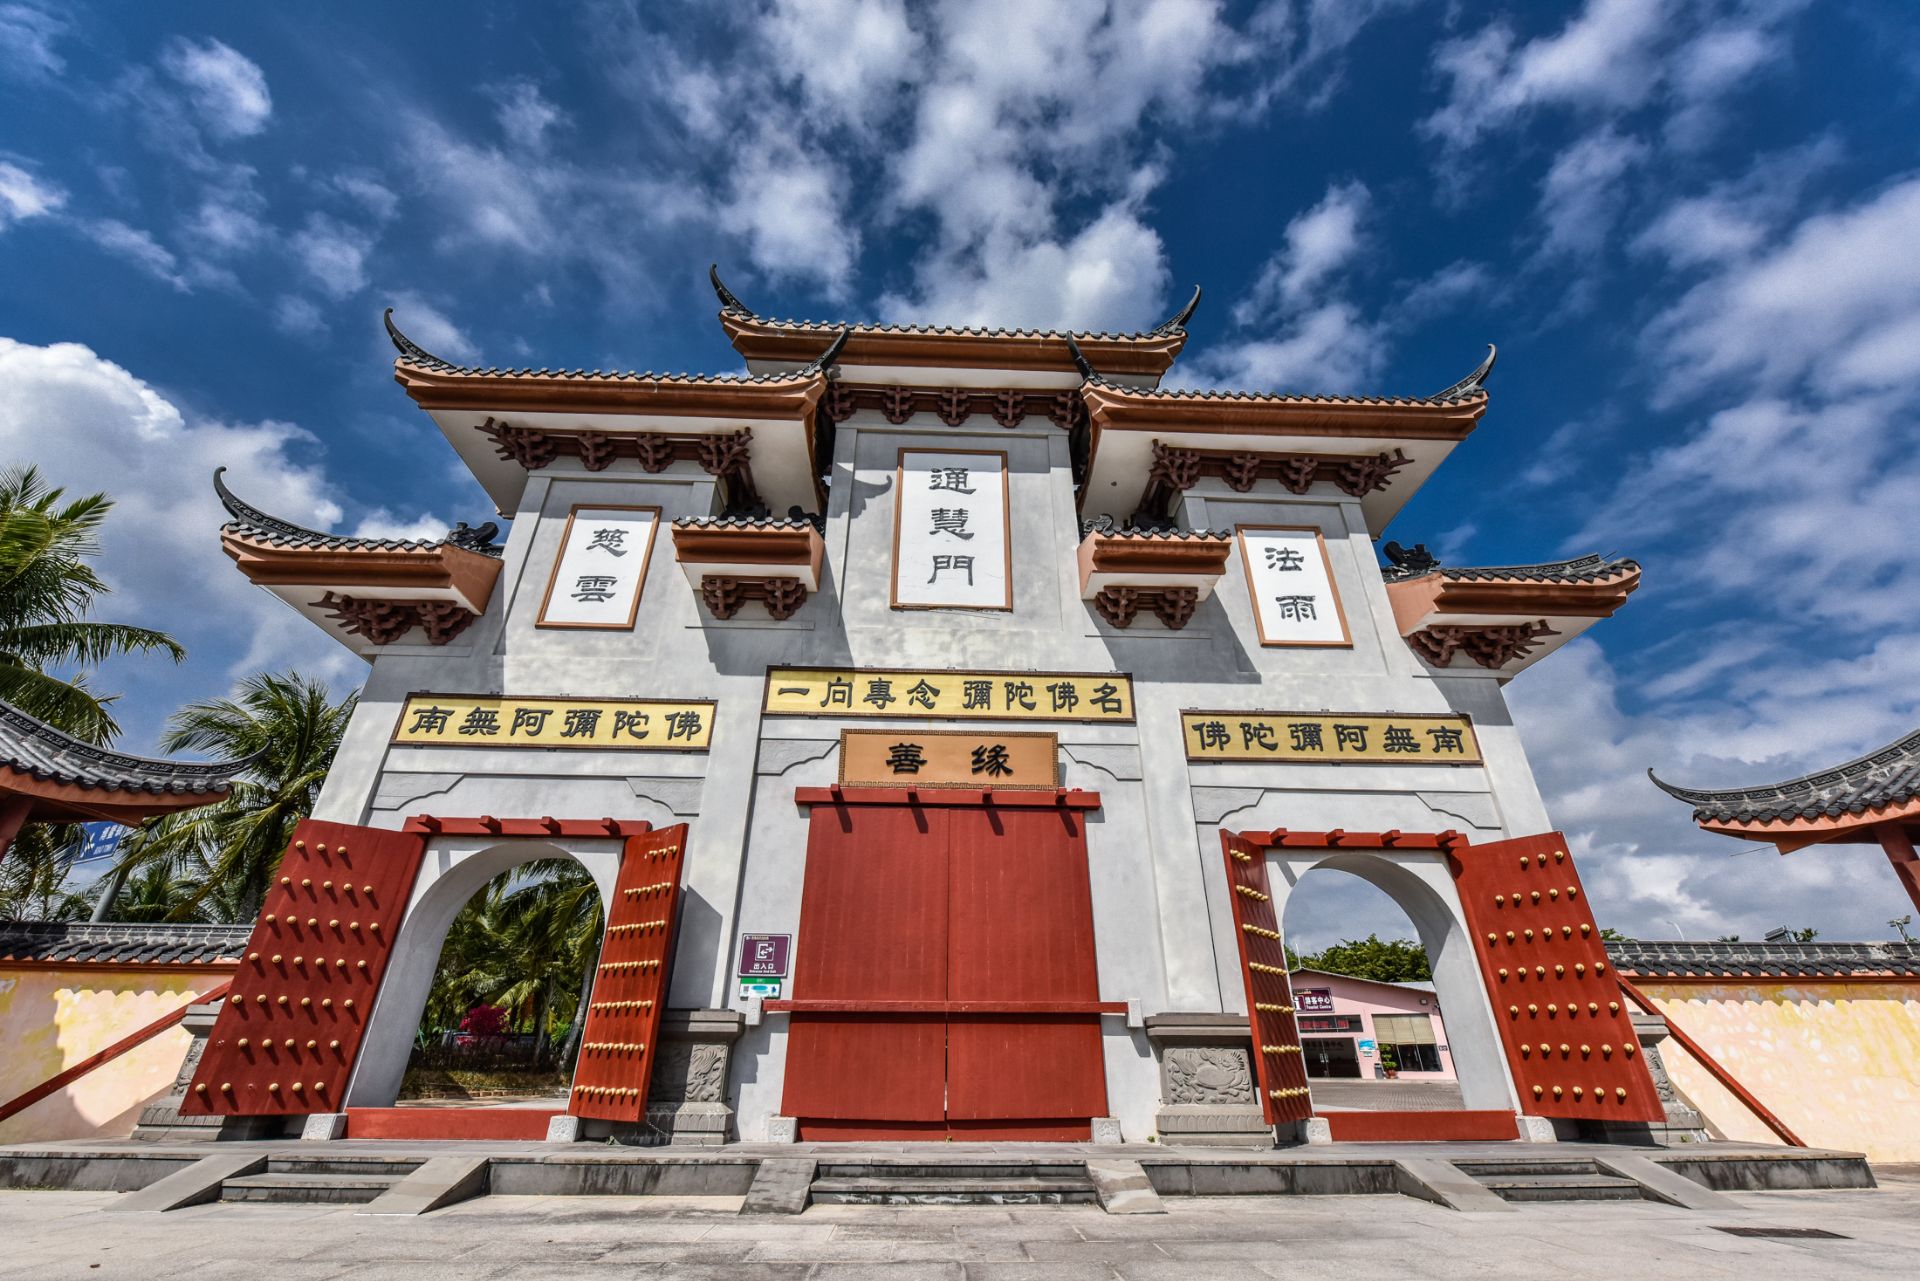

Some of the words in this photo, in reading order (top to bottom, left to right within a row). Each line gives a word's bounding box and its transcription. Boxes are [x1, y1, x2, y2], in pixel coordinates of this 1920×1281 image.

[927, 467, 977, 587] 通慧門
[1264, 547, 1317, 623] 法雨
[408, 706, 703, 742] 南無阿彌陀佛
[885, 742, 1014, 778] 善缘
